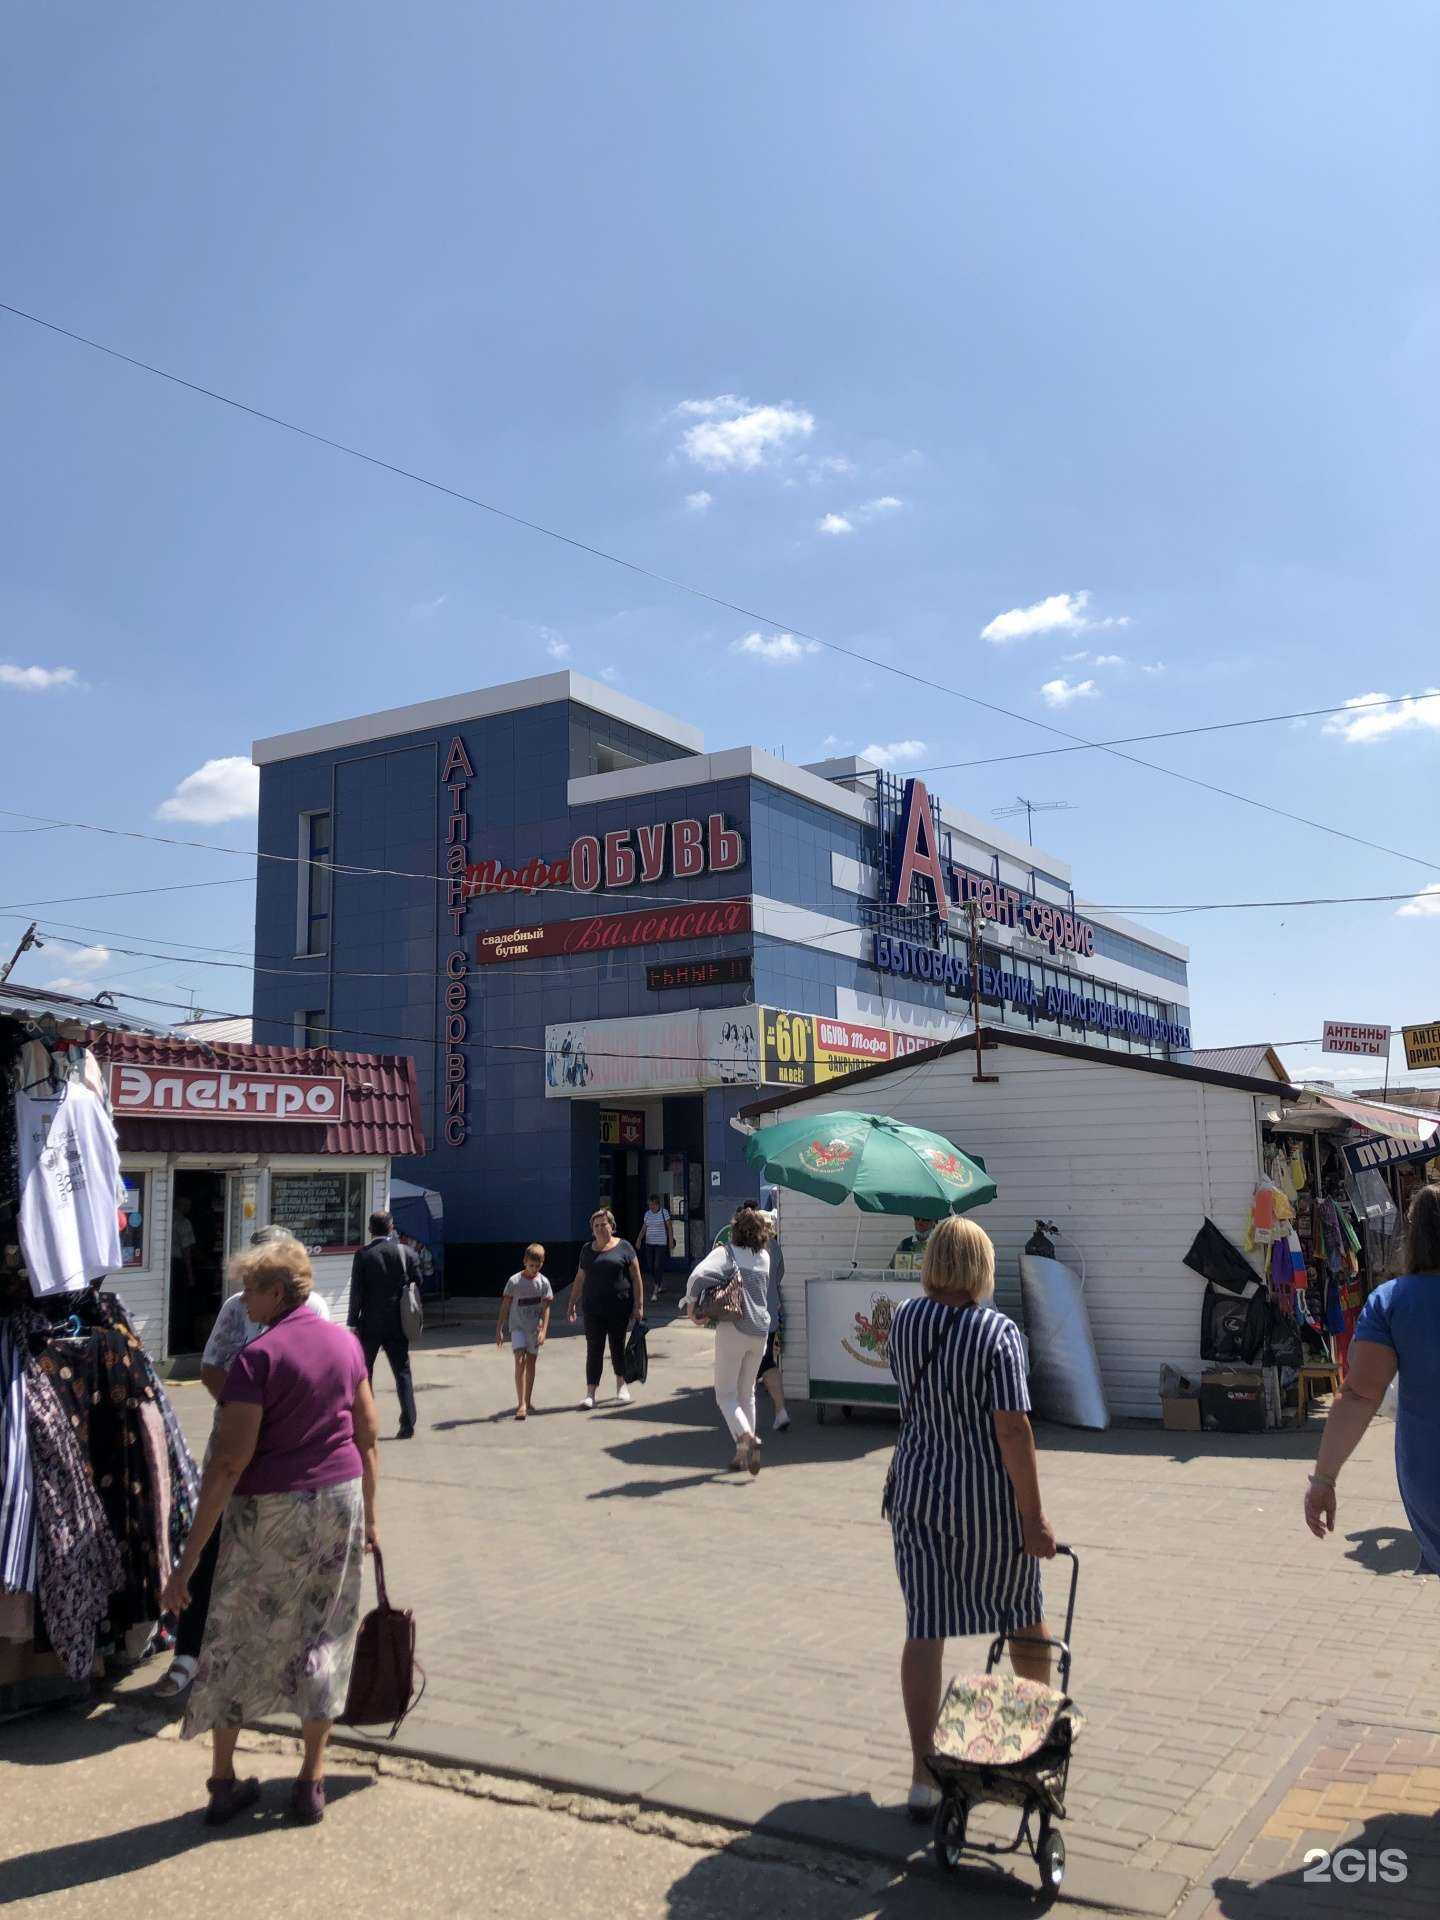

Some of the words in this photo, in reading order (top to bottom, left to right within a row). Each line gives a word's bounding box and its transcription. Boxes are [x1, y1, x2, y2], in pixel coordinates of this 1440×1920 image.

[570, 812, 742, 891] ОБУВЬ
[481, 927, 544, 946] свадебный
[495, 943, 529, 958] бутик
[874, 933, 968, 987] БЫТОВАЯ
[1047, 986, 1087, 1021] АУДИО
[1087, 998, 1126, 1031] ВИДЕО
[1125, 1009, 1191, 1049] КОМПЬЮТЕРЫ
[820, 1023, 849, 1046] ОБУВЬ
[850, 1032, 888, 1054] Тофа
[1326, 1026, 1387, 1041] АНТЕННЫ
[1329, 1039, 1380, 1053] ПУЛЬТЫ
[120, 1067, 336, 1119] Электро
